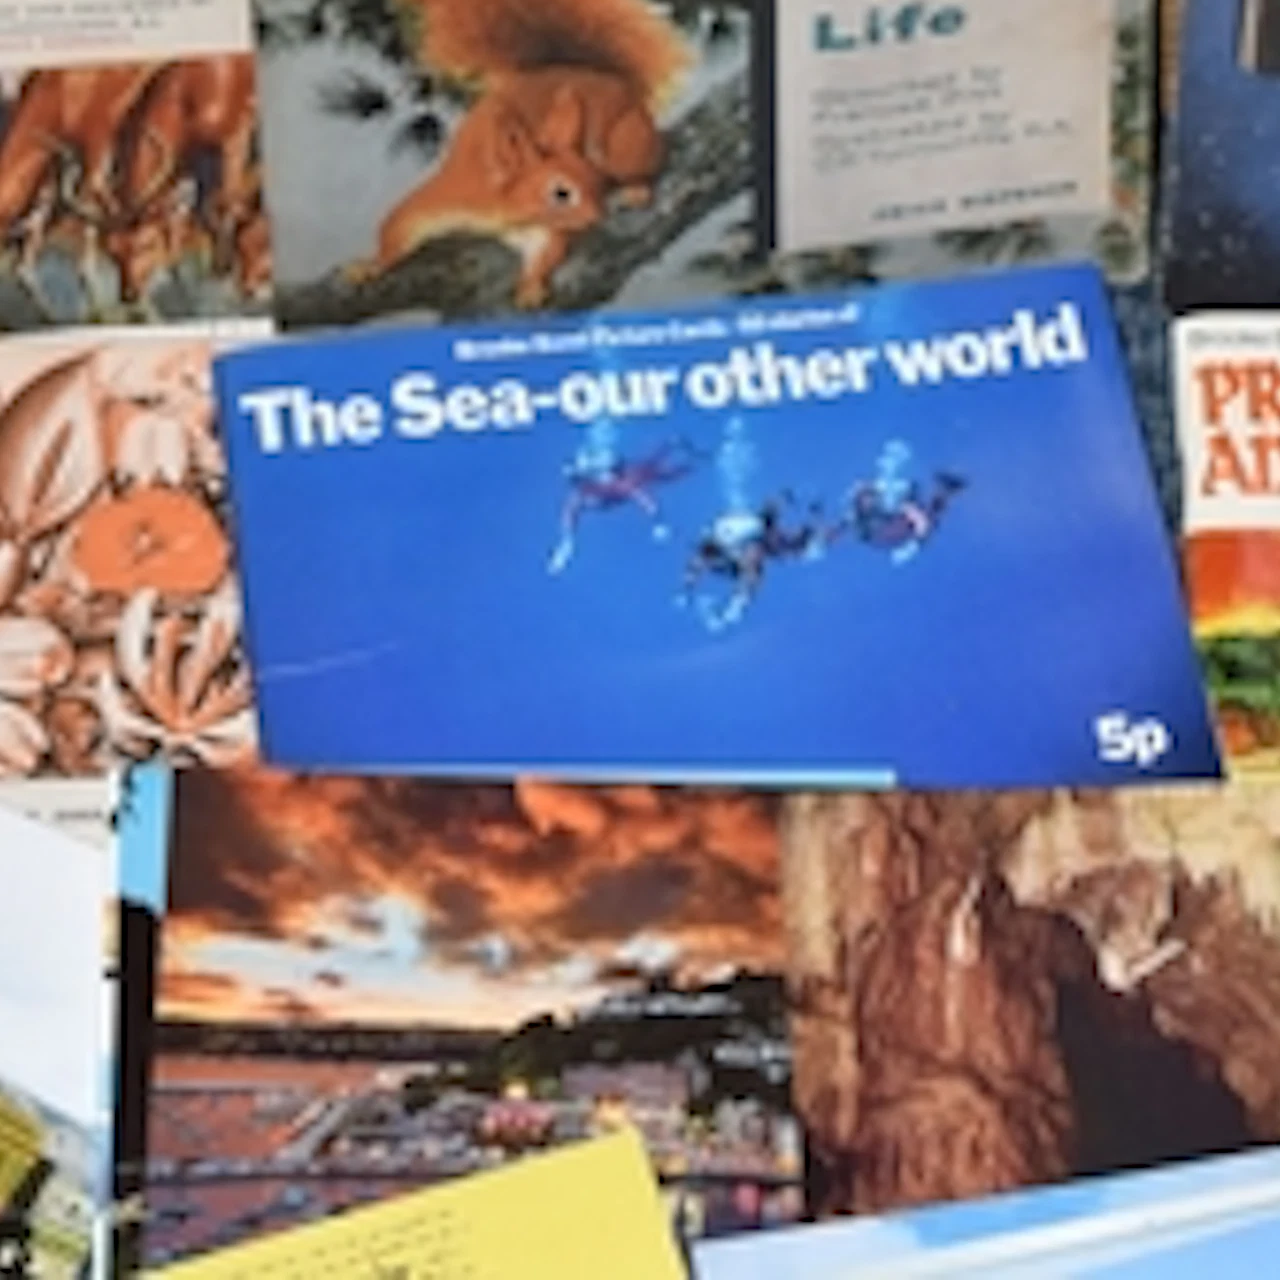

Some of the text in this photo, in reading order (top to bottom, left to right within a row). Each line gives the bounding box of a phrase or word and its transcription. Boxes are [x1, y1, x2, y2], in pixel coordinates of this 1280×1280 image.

[813, 0, 968, 52] Life
[239, 382, 383, 452] The
[390, 366, 678, 438] Sea-our
[687, 342, 878, 410] other
[884, 301, 1088, 385] world
[1093, 710, 1170, 768] 5p
